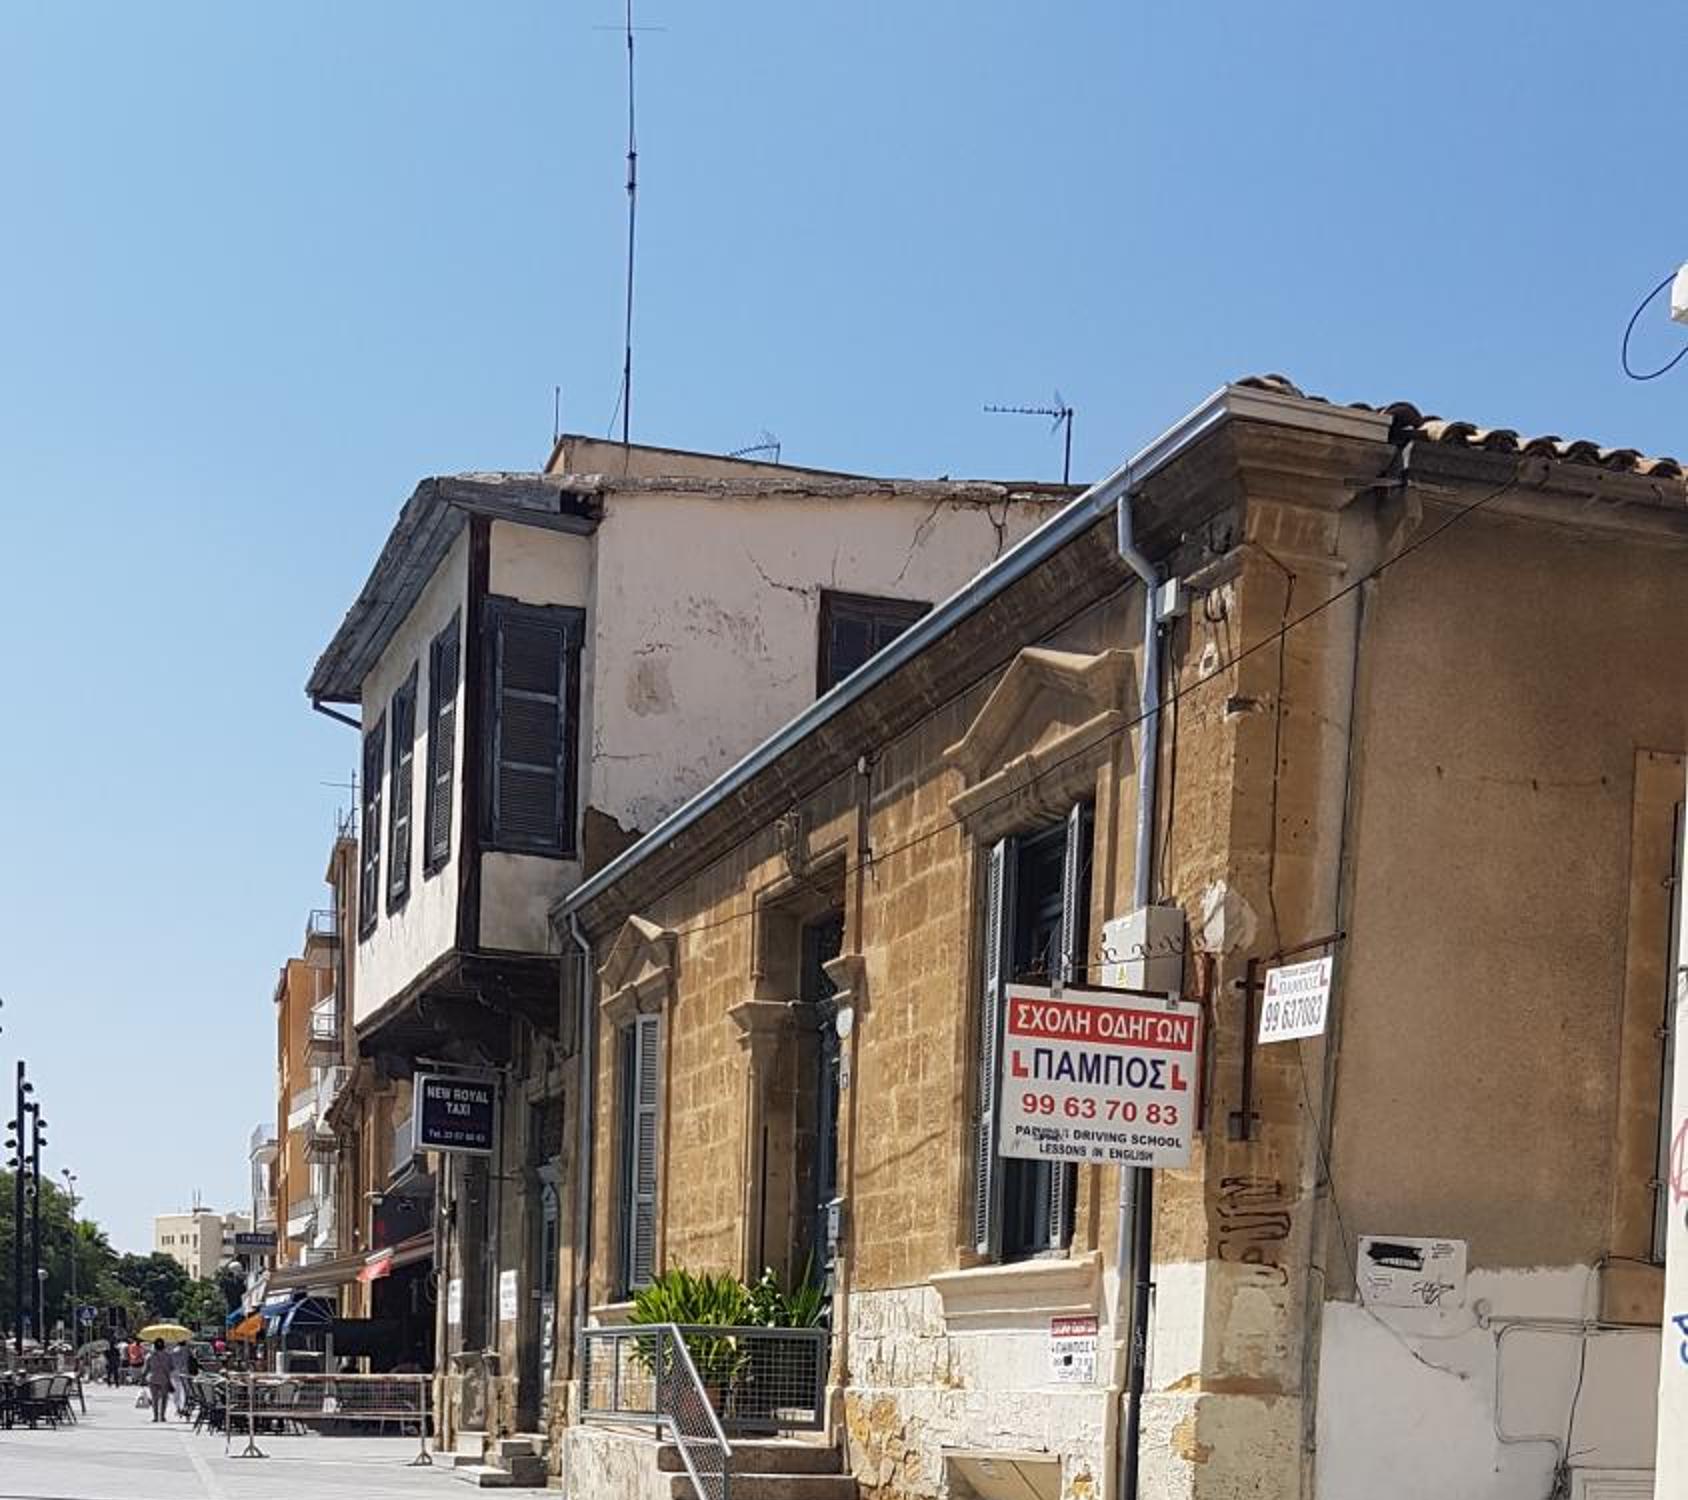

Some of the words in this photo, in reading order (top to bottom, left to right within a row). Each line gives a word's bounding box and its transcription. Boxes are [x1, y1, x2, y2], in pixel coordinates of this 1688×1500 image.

[1016, 1003, 1090, 1034] ΣΧΟΛΗ
[1097, 1012, 1188, 1044] ΟΔΗΓΩΝ
[1264, 1001, 1281, 1032] 99
[1034, 1048, 1166, 1090] ΠΑΜΠΟΣ
[426, 1086, 451, 1100] NEW
[453, 1088, 489, 1104] ROYAL
[446, 1102, 470, 1115] TAXI
[1023, 1093, 1055, 1115] 99
[1064, 1097, 1096, 1119] 63
[1106, 1100, 1137, 1122] 70
[1146, 1103, 1178, 1126] 83
[1073, 1128, 1127, 1144] DRIVING
[1131, 1133, 1182, 1149] SCHOOL
[1039, 1143, 1087, 1157] LESSONS
[1109, 1147, 1154, 1162] ENGLISH
